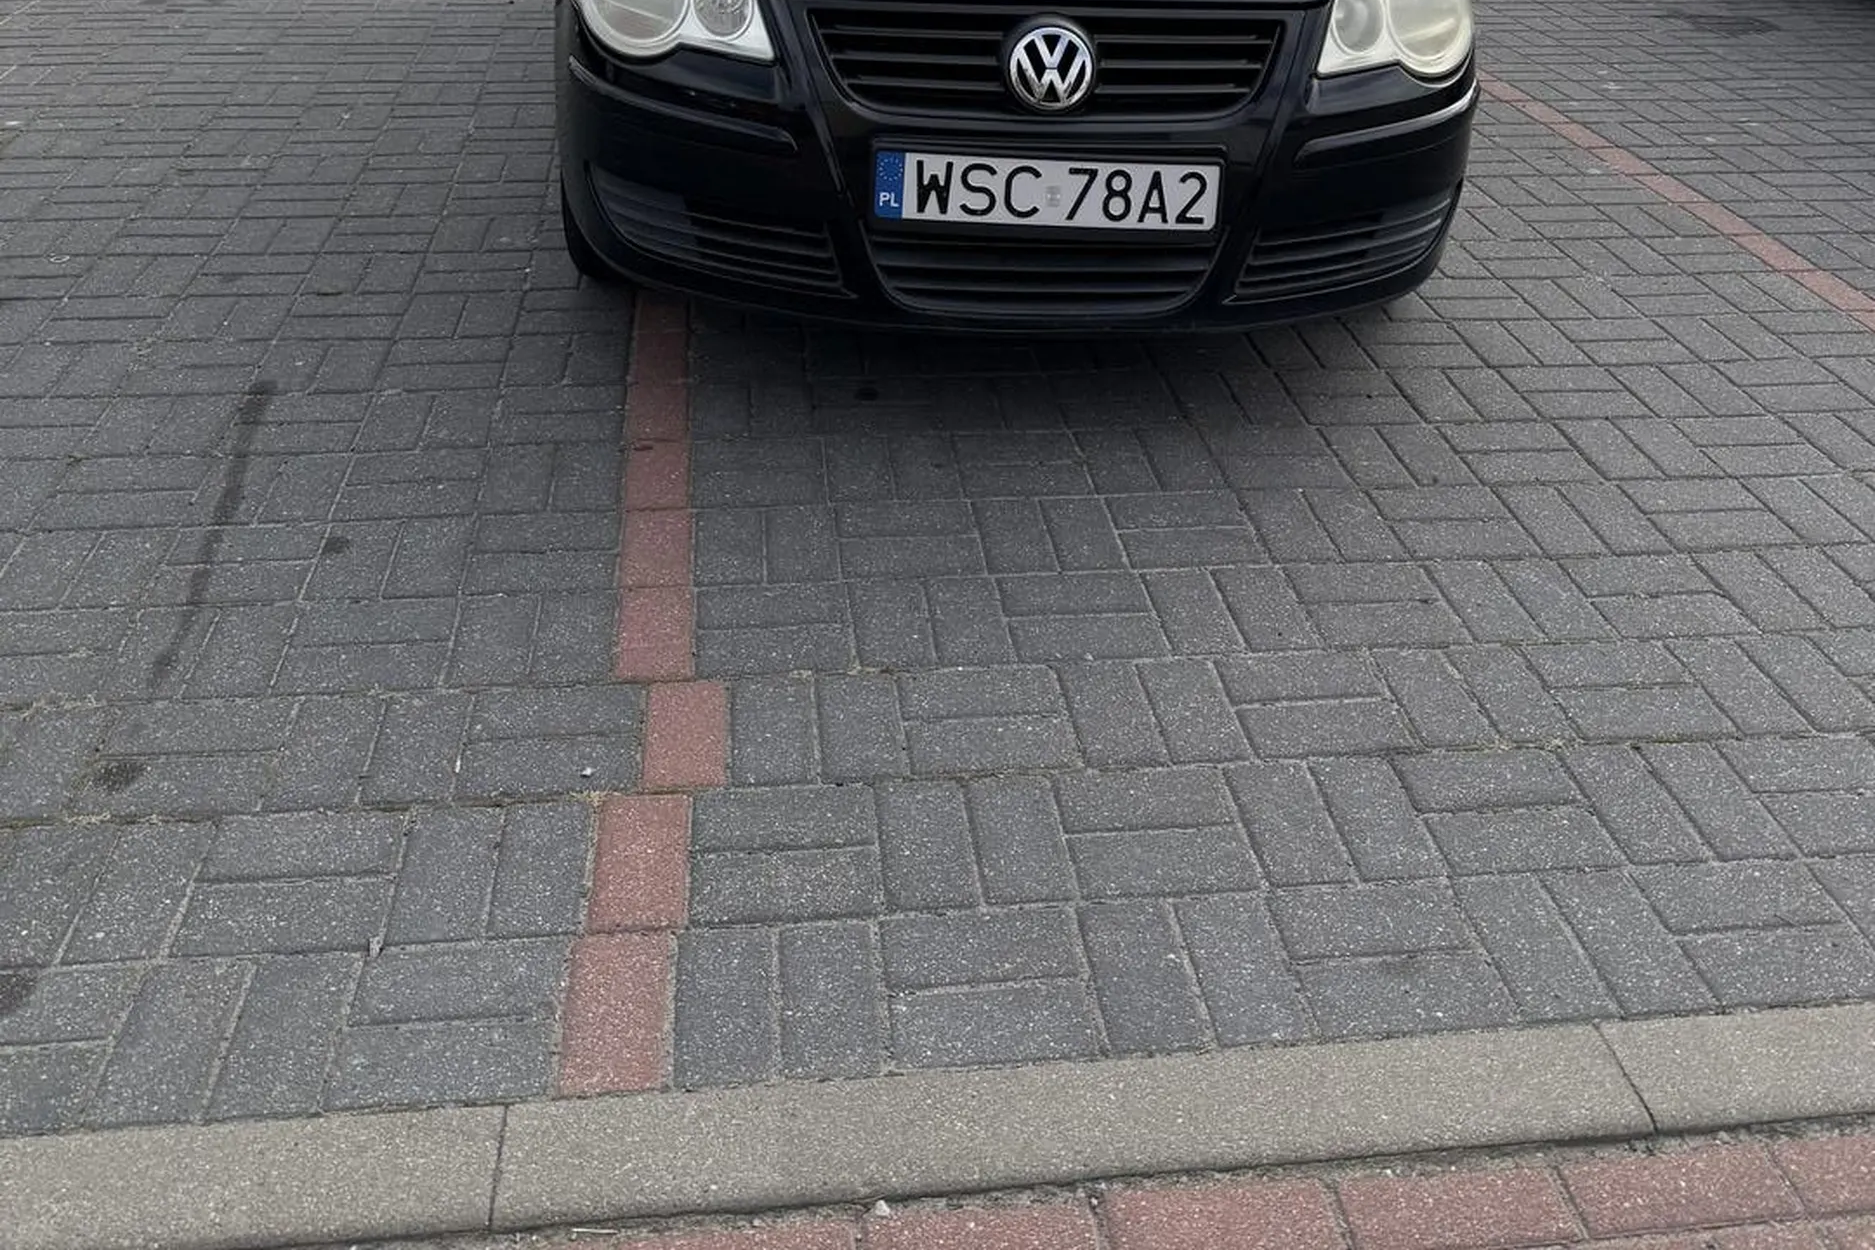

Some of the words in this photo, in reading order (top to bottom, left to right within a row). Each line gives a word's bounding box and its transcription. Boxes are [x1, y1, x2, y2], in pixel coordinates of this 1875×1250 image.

[1010, 27, 1093, 110] VW
[879, 191, 900, 208] PL
[915, 158, 1043, 219] WSC
[1064, 166, 1208, 225] 78A2
